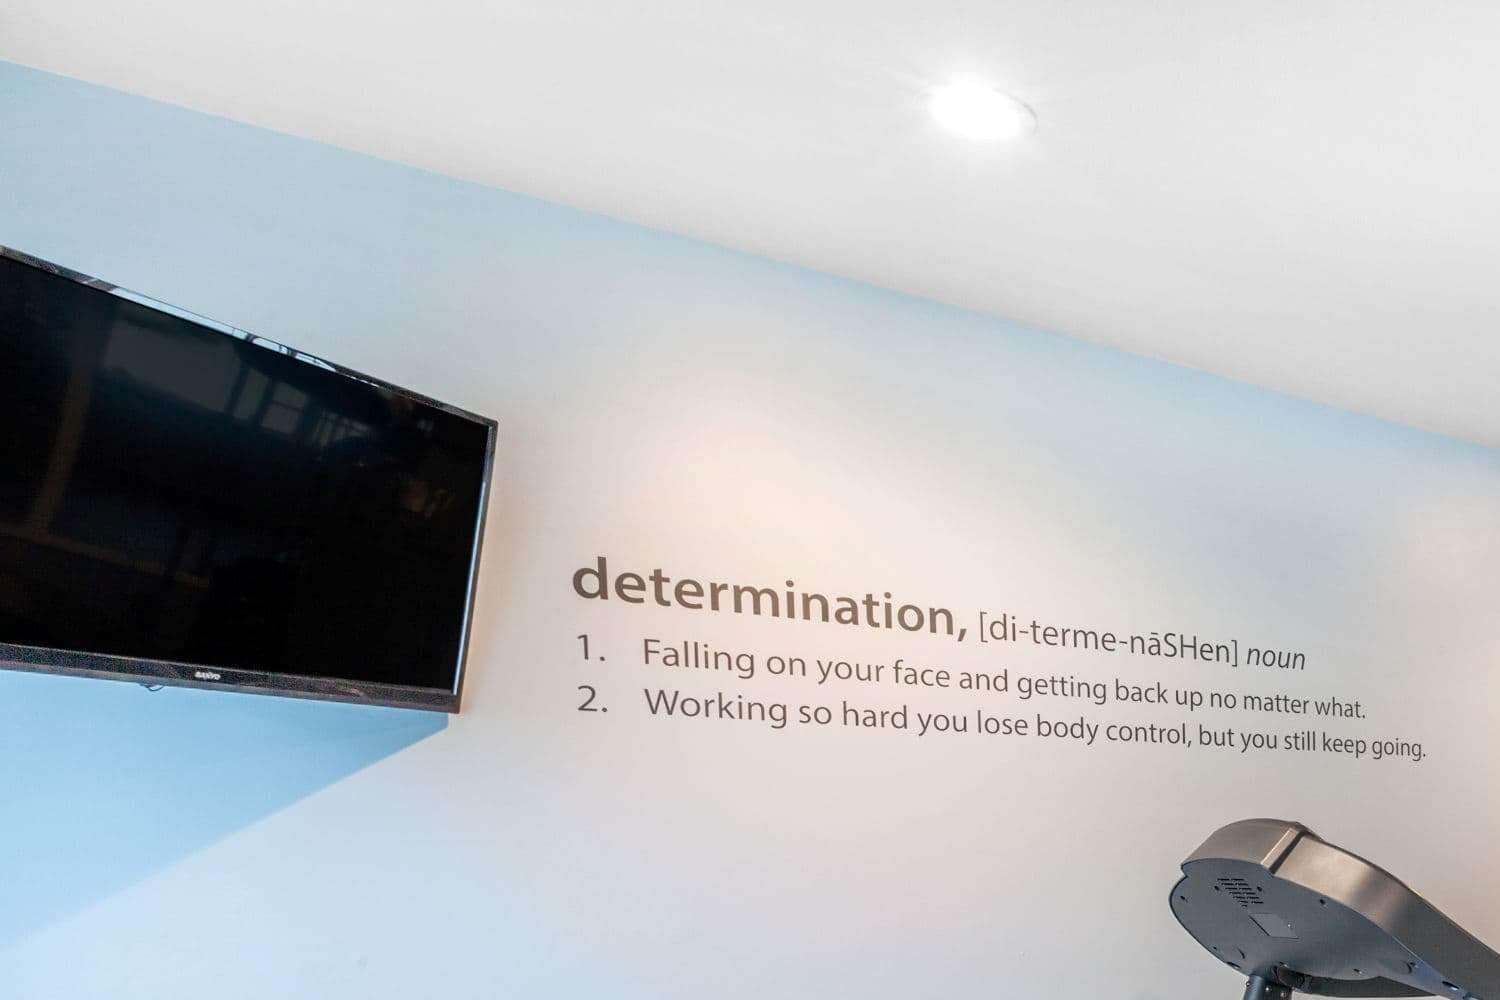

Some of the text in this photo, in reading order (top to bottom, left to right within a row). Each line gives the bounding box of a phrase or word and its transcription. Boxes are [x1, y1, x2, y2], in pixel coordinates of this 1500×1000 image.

[572, 556, 968, 643] determination,
[1246, 646, 1306, 670] noun
[576, 634, 1366, 720] 1. Falling on your face and getting back up no matter what.
[576, 684, 1427, 761] 2. Working so hard you lose body control, but you still keep going.
